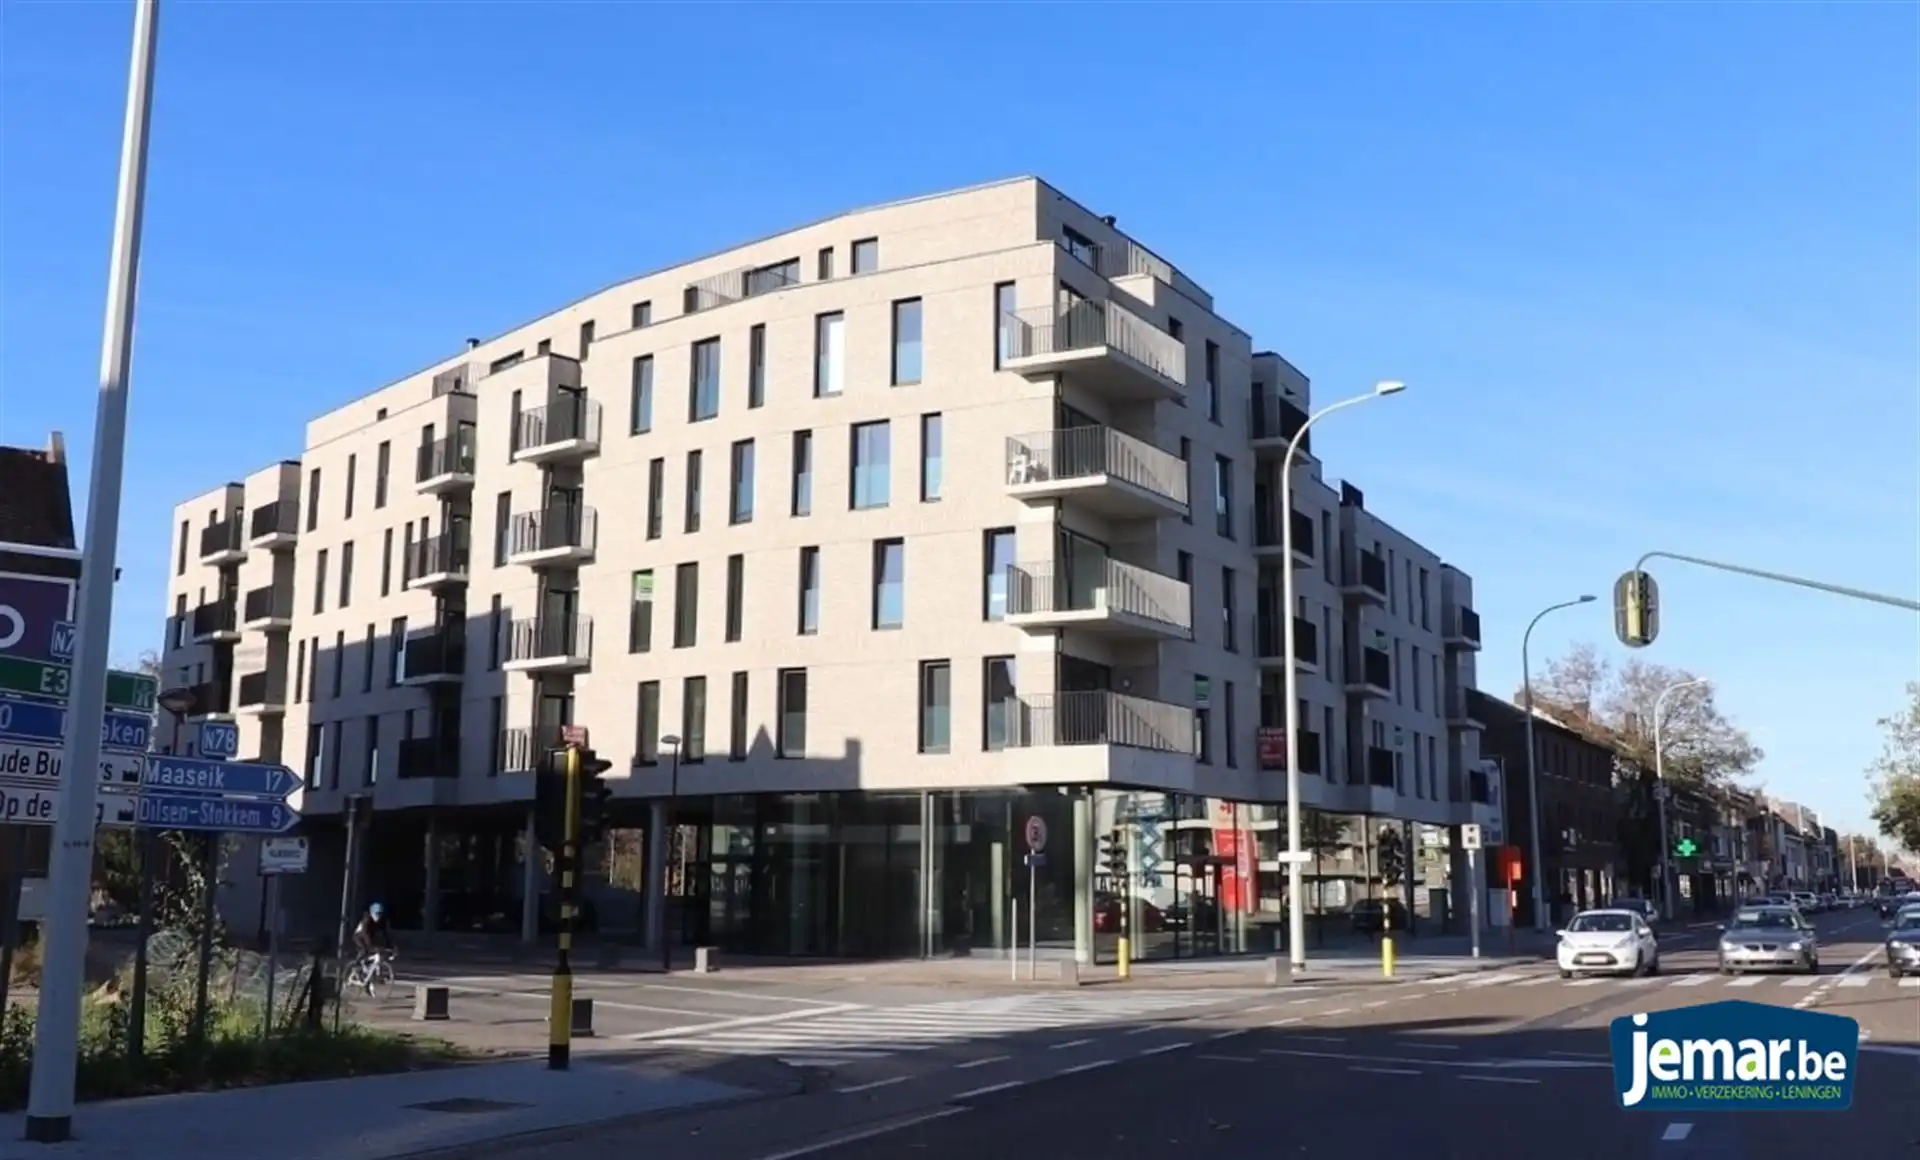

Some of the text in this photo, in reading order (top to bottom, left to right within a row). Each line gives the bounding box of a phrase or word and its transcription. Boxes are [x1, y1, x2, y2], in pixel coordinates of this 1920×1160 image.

[53, 628, 76, 653] N7
[203, 728, 237, 752] N78
[144, 759, 284, 792] Maaseik 17
[26, 792, 53, 818] de
[139, 798, 282, 828] Dilsen-Stokkem 9
